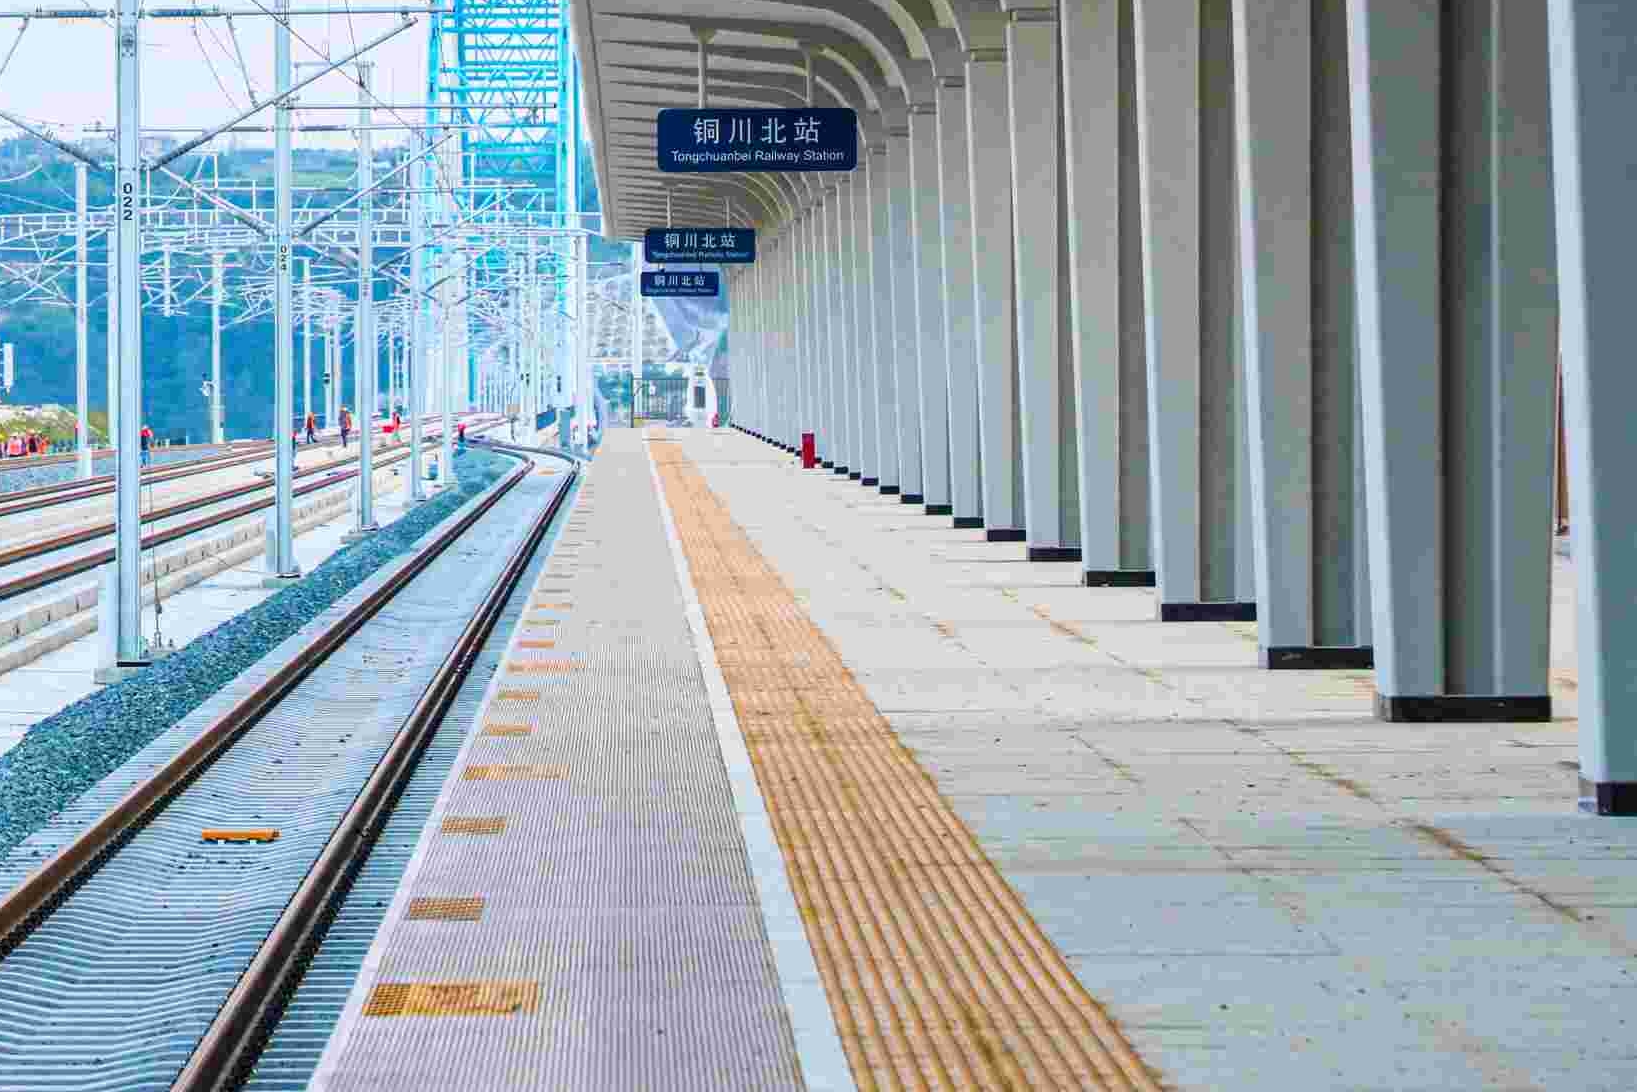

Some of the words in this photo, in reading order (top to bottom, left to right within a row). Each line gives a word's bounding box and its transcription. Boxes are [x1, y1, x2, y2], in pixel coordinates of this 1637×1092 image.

[693, 116, 821, 144] 铜川北站
[670, 149, 752, 164] Tongchuanbei
[756, 149, 799, 163] Railway
[803, 148, 845, 161] Station
[122, 182, 133, 221] 022
